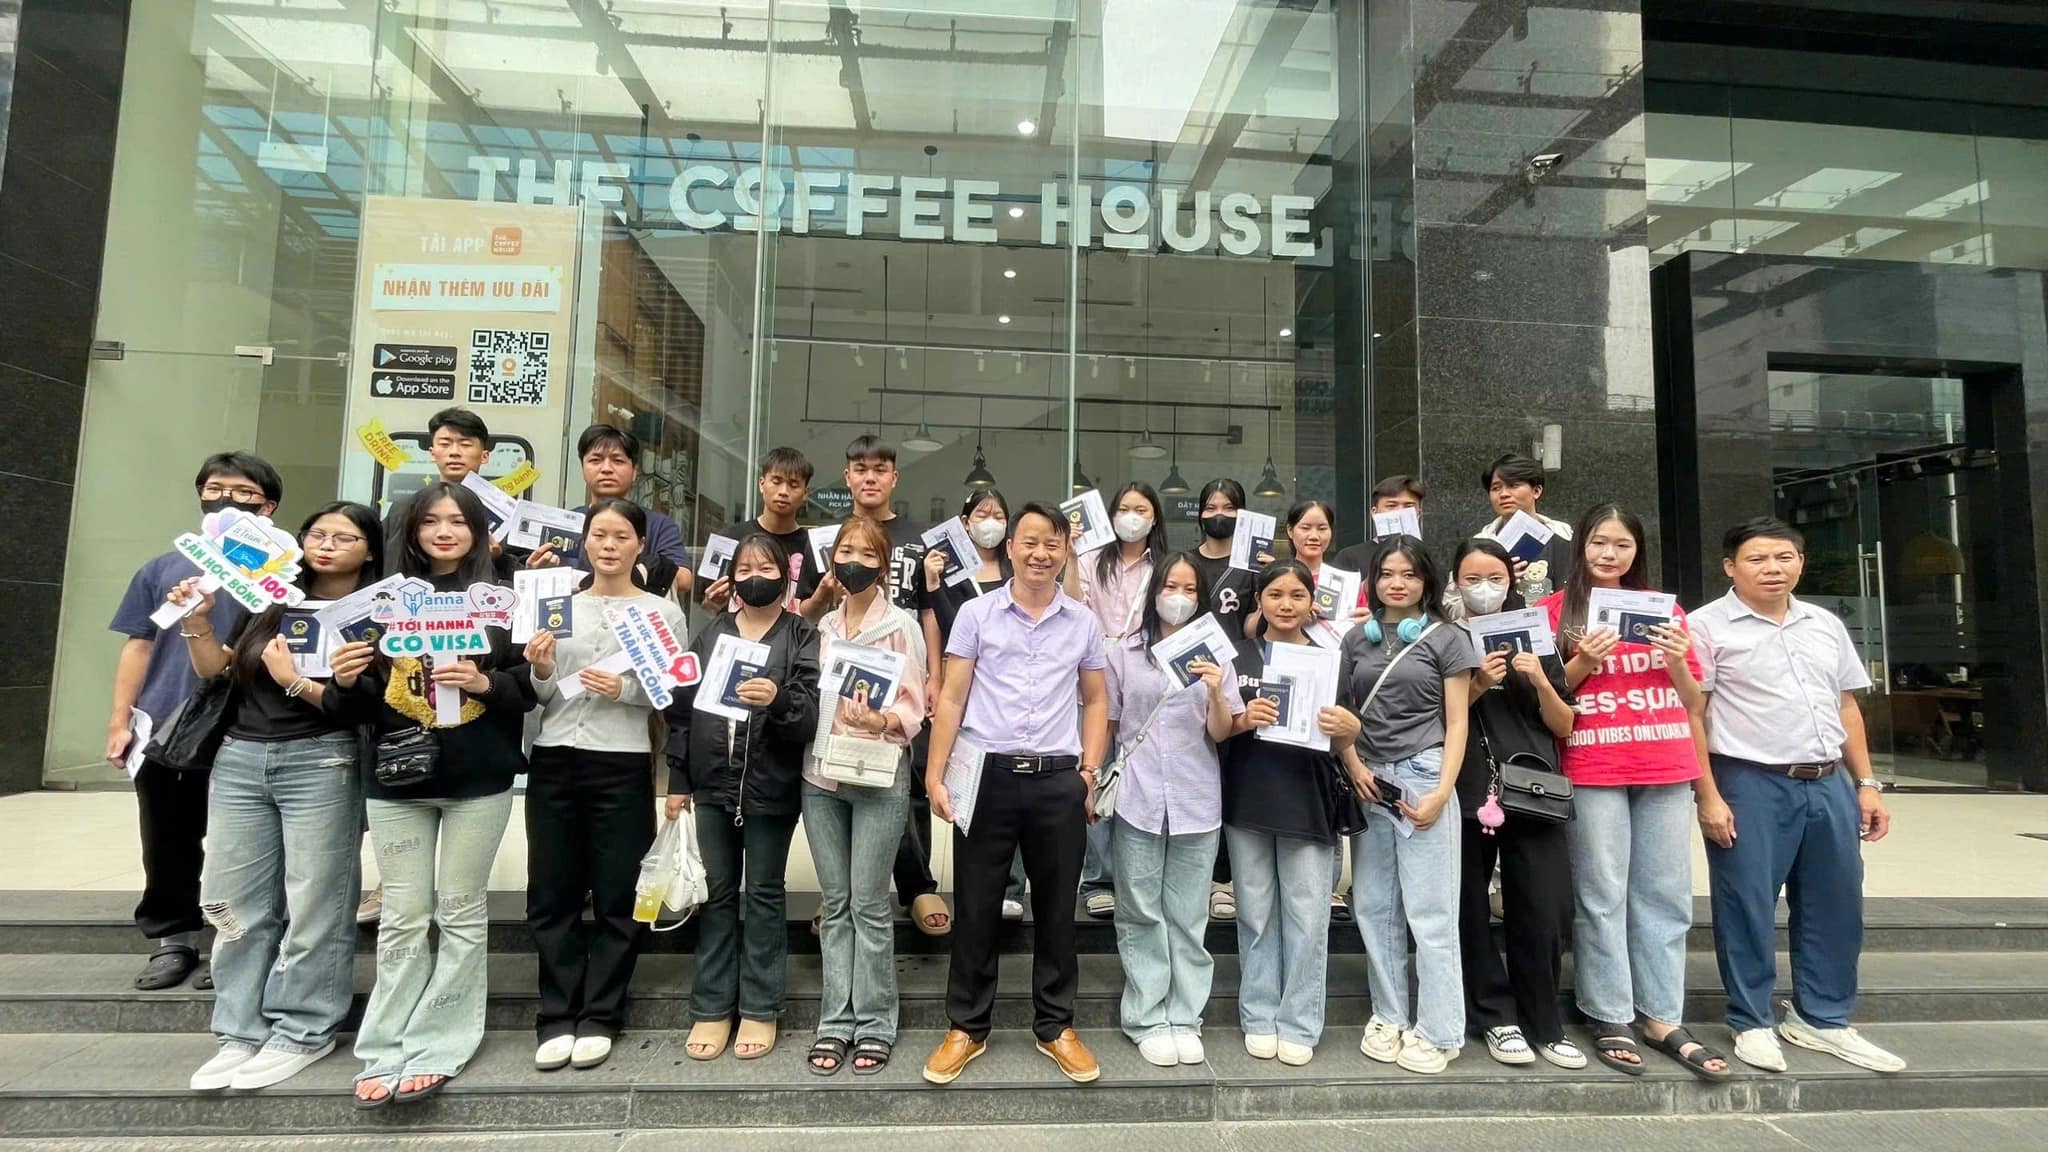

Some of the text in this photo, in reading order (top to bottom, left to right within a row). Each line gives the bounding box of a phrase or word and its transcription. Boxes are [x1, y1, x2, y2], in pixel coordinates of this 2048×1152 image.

[468, 155, 1316, 257] THE COFFEE HOUSE
[453, 237, 484, 252] APP
[383, 277, 431, 299] NHẬN
[439, 278, 485, 297] THÊM
[399, 353, 454, 366] Google play
[396, 382, 450, 395] App Store
[364, 432, 393, 464] DRINK
[375, 431, 399, 455] FREE
[203, 556, 228, 582] HỌC
[426, 619, 475, 631] HANNA
[647, 610, 679, 657] HANNA
[387, 631, 484, 652] CÓ VISA
[615, 621, 669, 706] THÀNH CÔNG
[1576, 687, 1684, 715] ES-SUR
[1597, 726, 1632, 745] VIBES
